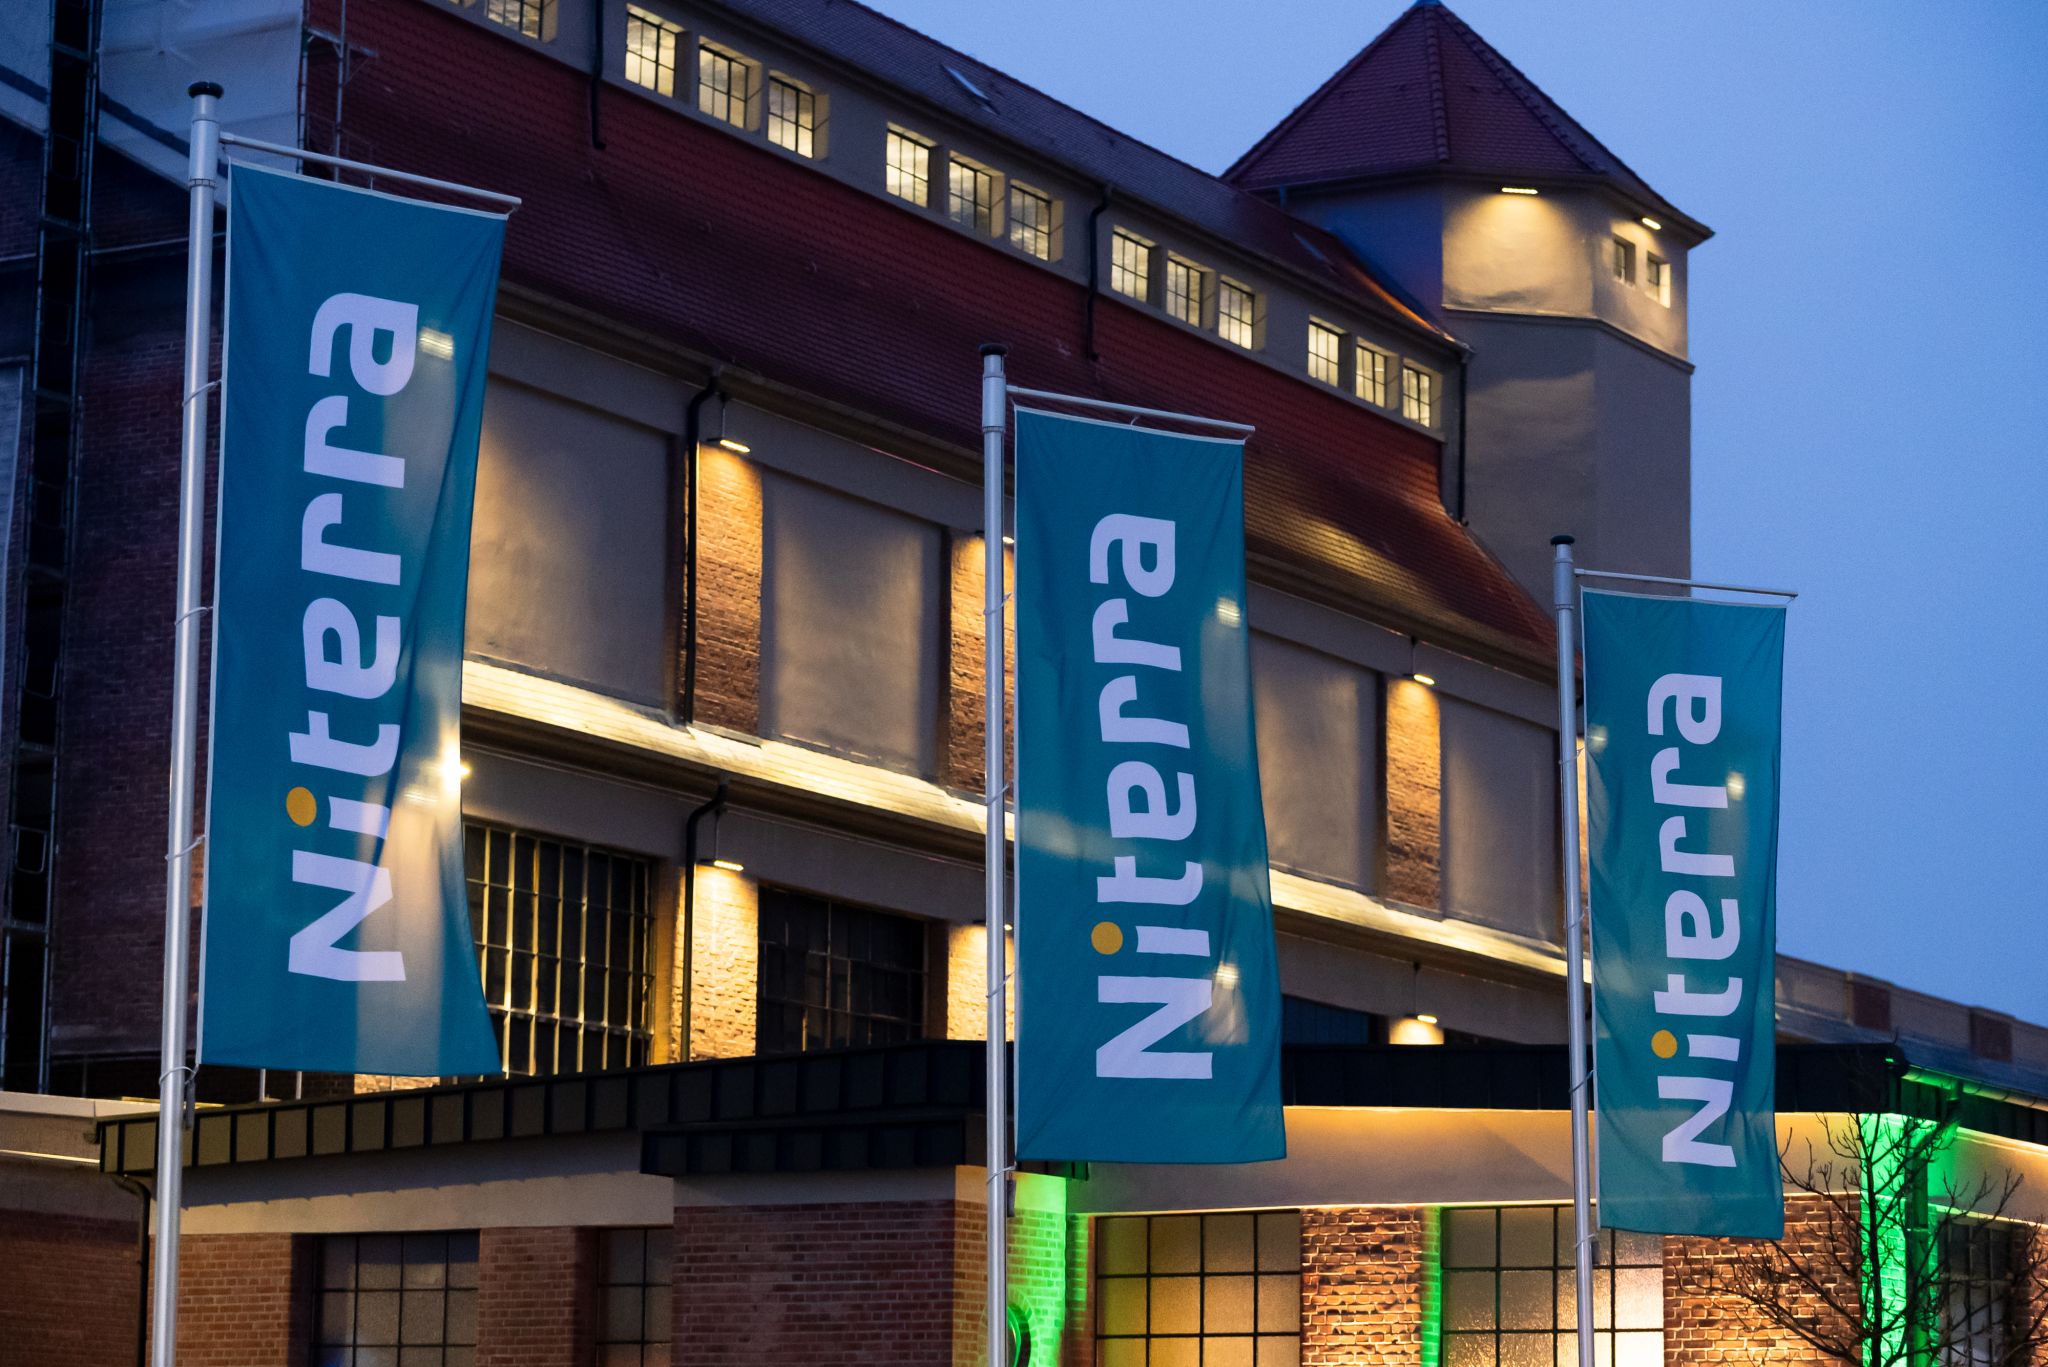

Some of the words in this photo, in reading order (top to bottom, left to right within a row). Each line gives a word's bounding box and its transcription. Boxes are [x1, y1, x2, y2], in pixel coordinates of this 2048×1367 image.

[286, 292, 419, 981] Niterra
[1089, 513, 1213, 1079] Niterra
[1647, 673, 1743, 1168] Niterra
